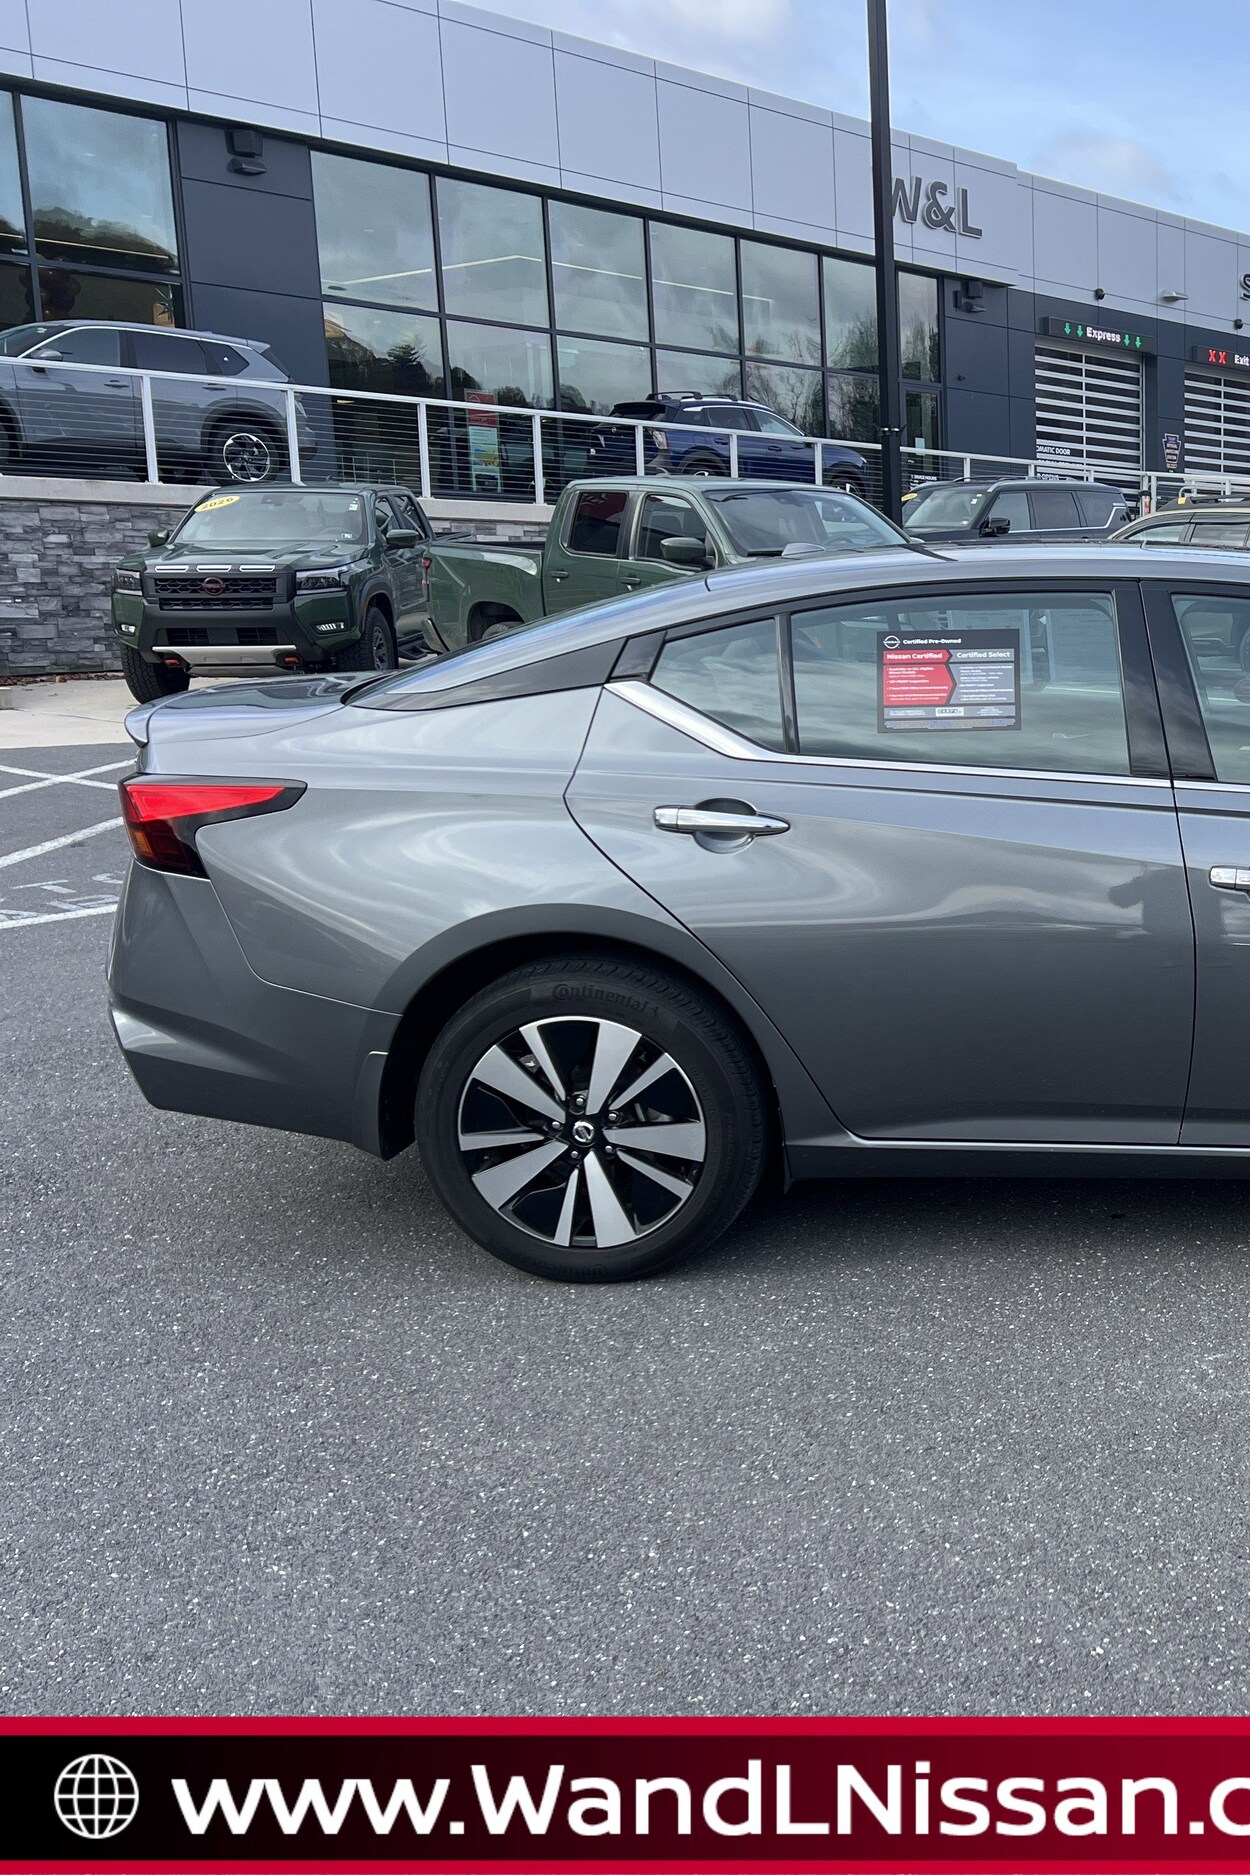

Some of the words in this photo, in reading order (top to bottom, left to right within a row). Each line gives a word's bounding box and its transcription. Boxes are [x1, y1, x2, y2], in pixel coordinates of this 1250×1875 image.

[1086, 326, 1121, 343] Express
[1234, 354, 1250, 367] Exit
[911, 652, 943, 660] Certified
[956, 651, 987, 659] Certified
[552, 983, 649, 1013] Continental
